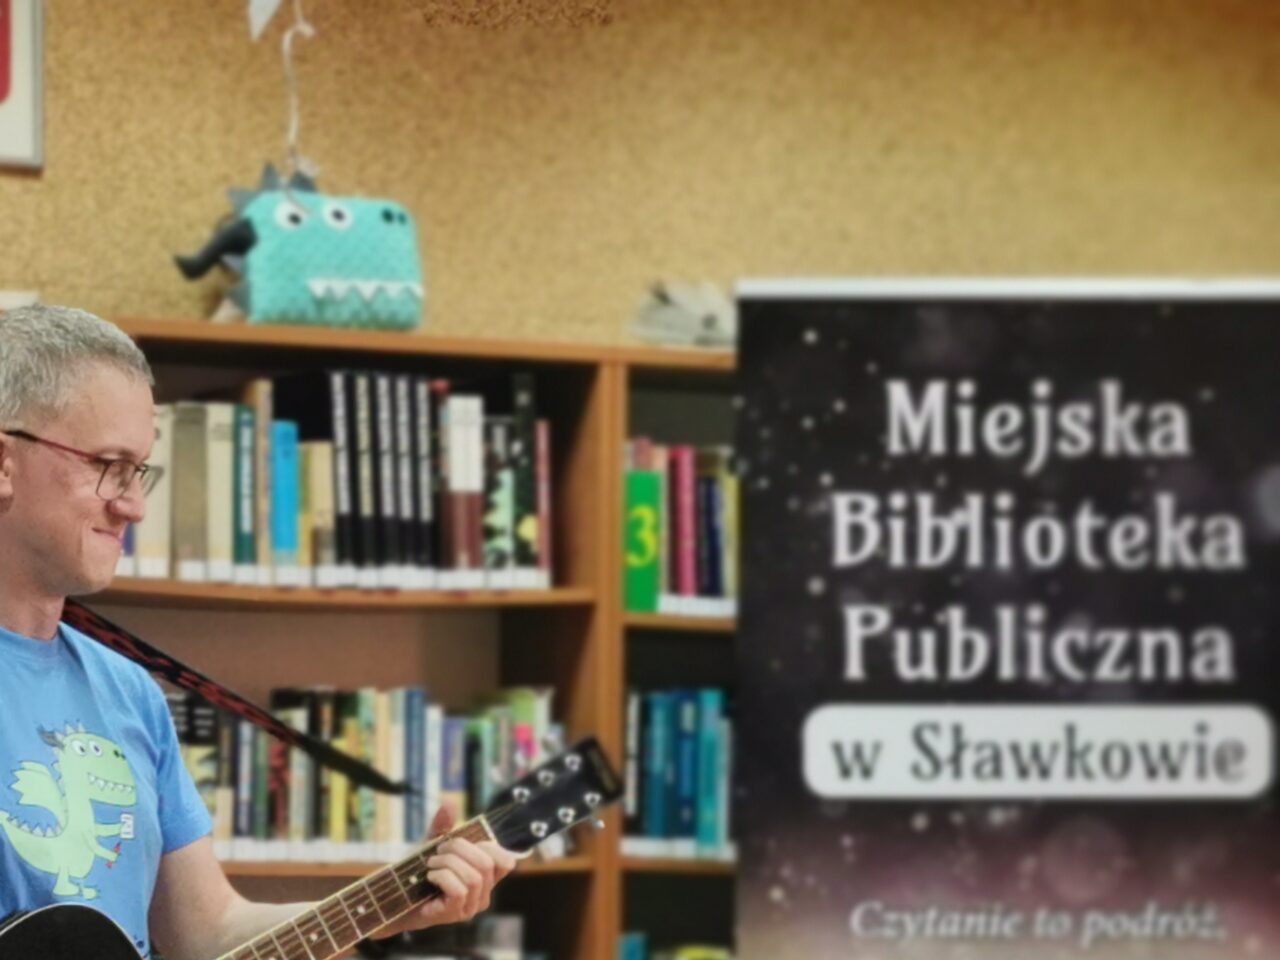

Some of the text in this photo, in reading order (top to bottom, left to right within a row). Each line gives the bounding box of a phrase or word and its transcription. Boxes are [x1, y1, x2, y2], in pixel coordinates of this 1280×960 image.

[884, 377, 1192, 475] Miejska
[624, 503, 660, 569] 3
[830, 492, 1248, 571] Biblioteka
[842, 602, 1238, 683] Publiczna
[830, 721, 1249, 783] w Sławkowie
[849, 900, 1021, 950] Czytanie
[1033, 905, 1070, 939] to
